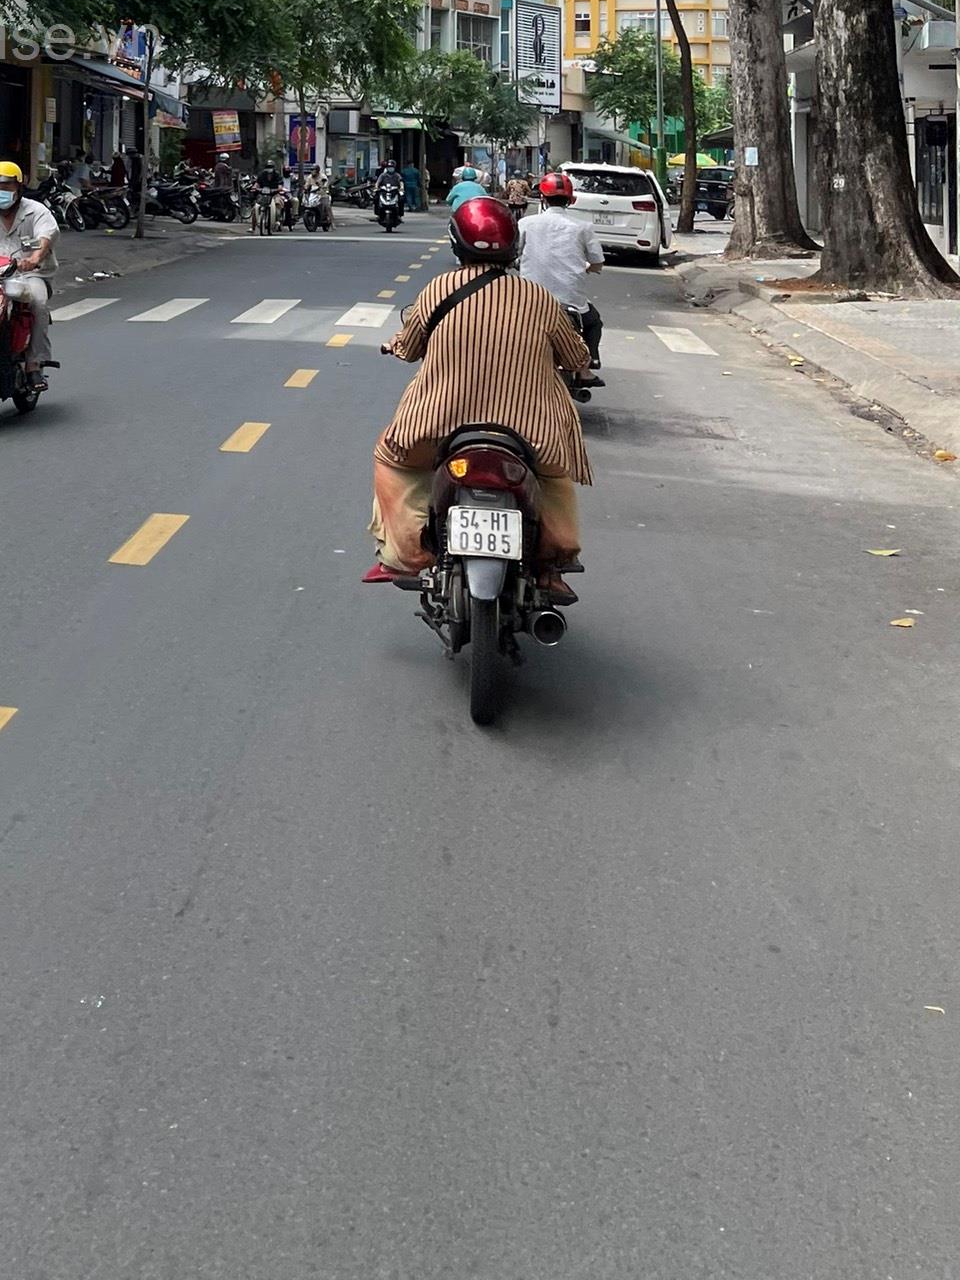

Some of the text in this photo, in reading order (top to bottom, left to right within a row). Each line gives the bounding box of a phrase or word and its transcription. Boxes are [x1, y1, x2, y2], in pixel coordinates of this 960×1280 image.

[833, 178, 845, 188] 29
[459, 510, 508, 532] 54-H1
[459, 531, 511, 554] 0985
